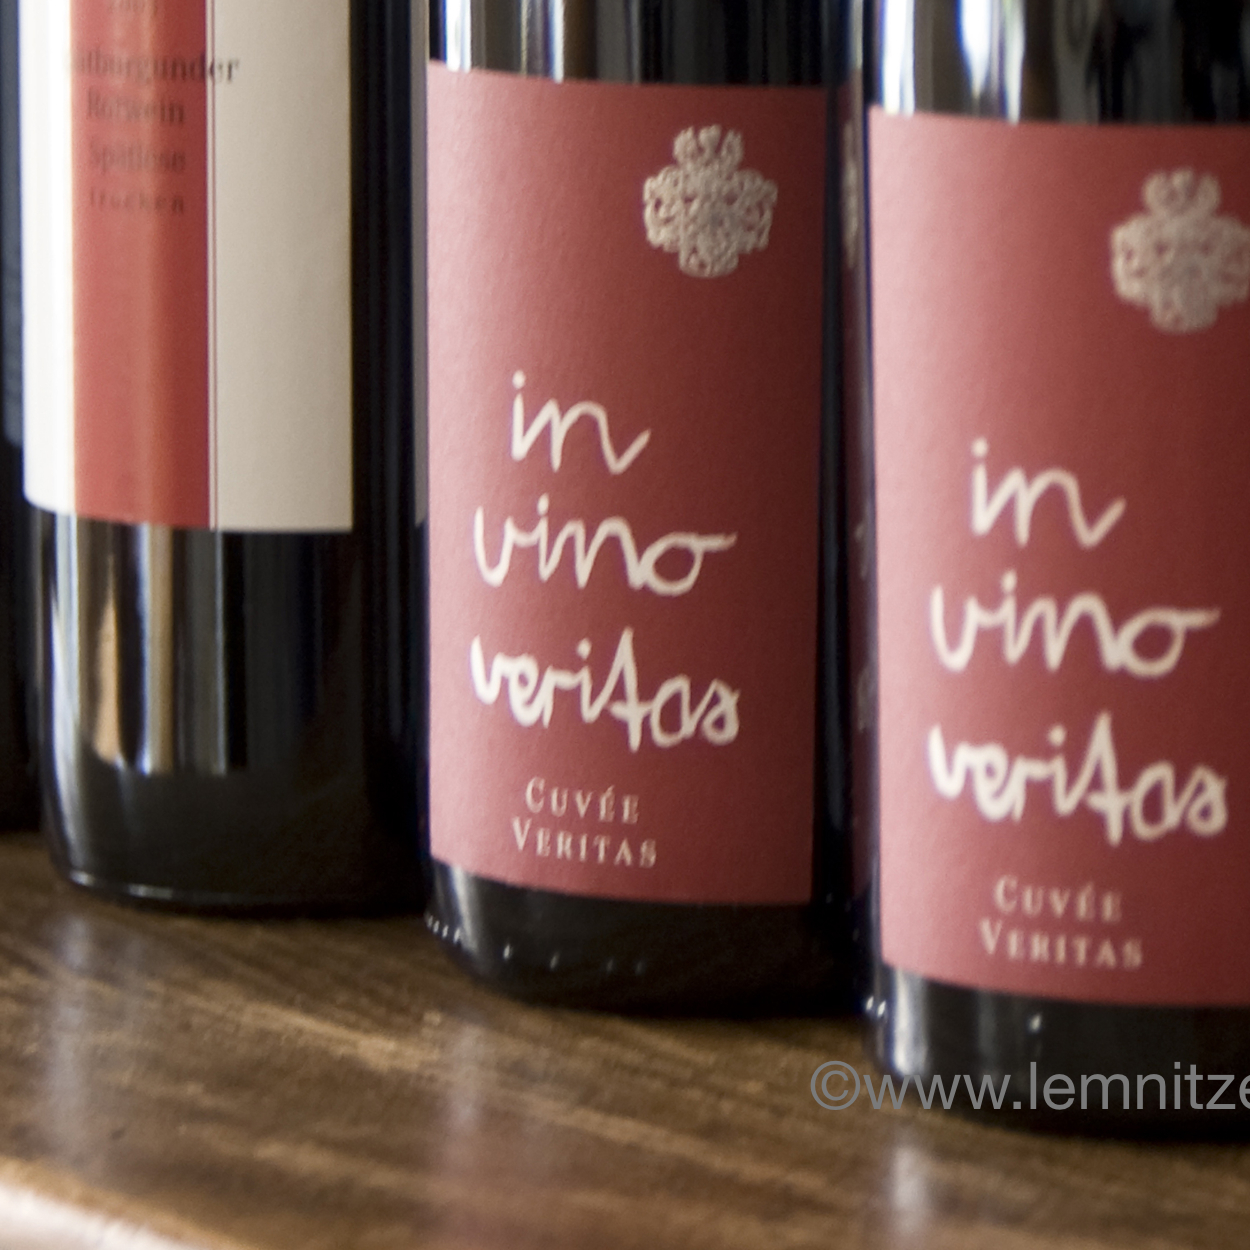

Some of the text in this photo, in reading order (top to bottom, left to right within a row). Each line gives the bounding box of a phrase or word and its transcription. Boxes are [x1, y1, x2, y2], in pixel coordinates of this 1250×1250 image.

[512, 369, 652, 475] in
[473, 493, 738, 596] vino
[971, 437, 1127, 548] in
[929, 569, 1221, 678] vino
[469, 626, 740, 753] veritas
[928, 710, 1229, 847] veritas
